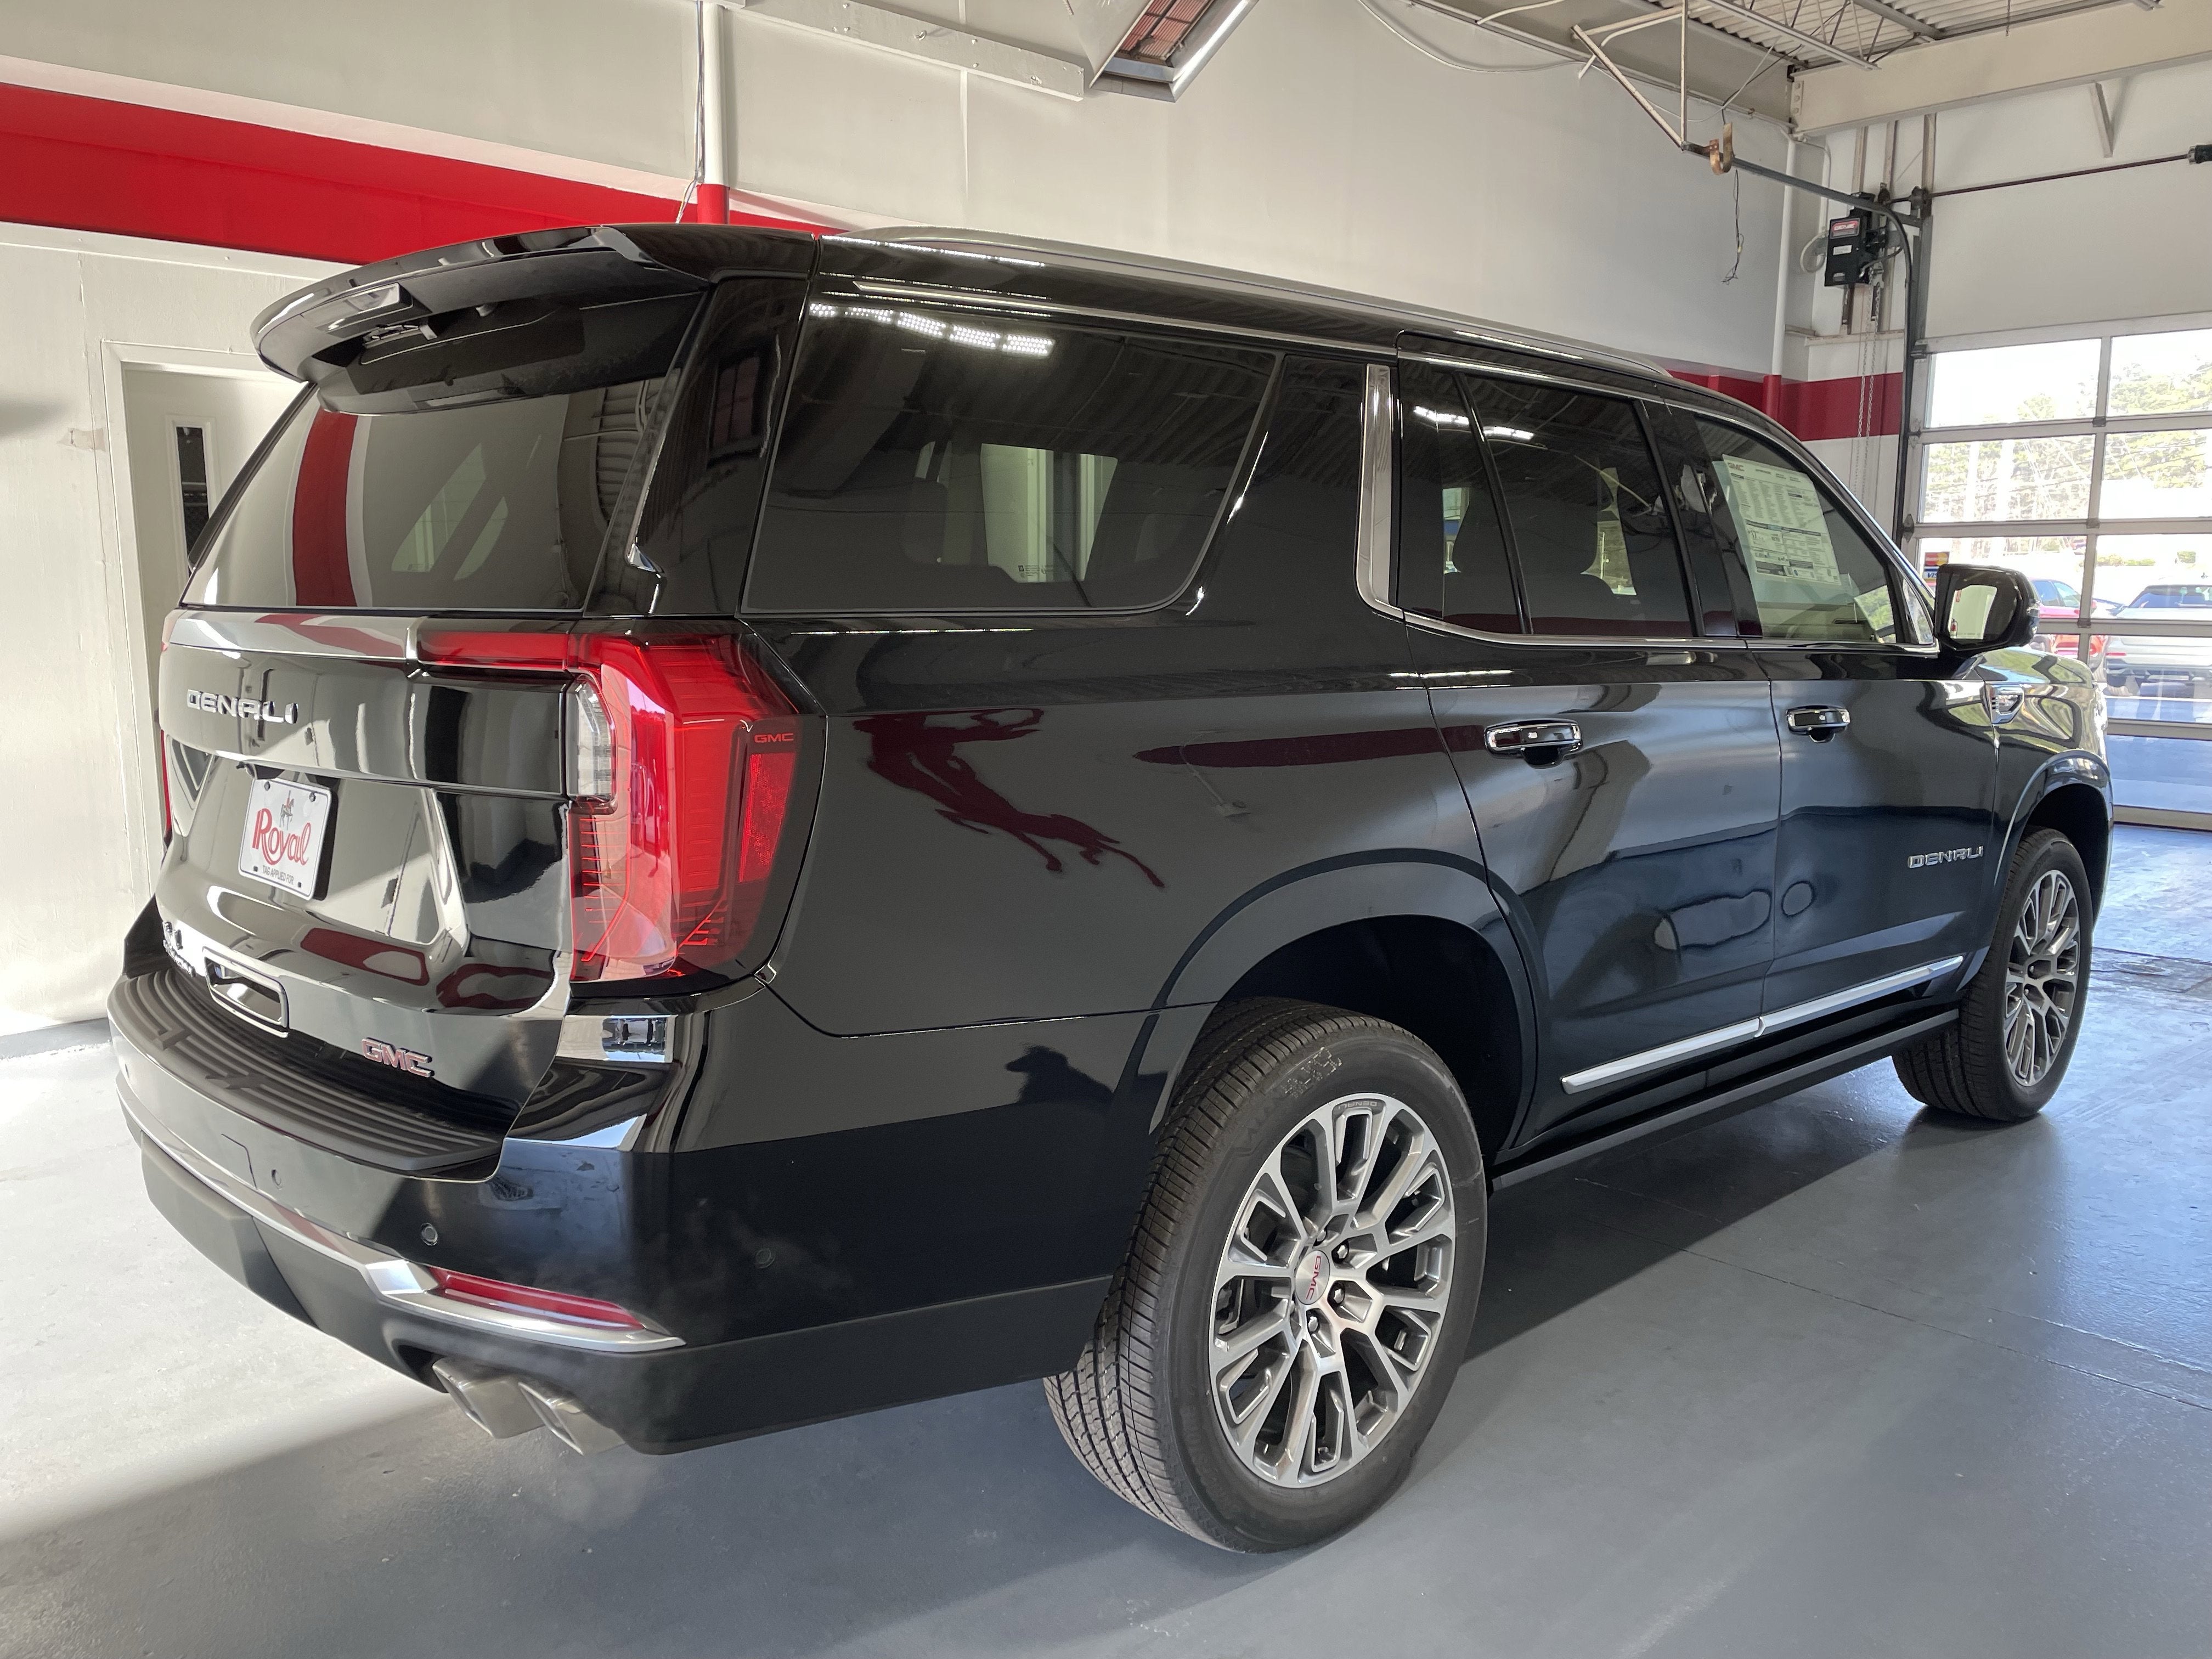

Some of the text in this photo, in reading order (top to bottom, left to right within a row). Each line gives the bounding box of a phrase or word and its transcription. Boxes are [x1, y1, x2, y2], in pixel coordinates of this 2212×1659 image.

[1728, 462, 1745, 472] GMC
[187, 689, 298, 724] DENALI
[754, 733, 794, 743] GMC
[252, 808, 311, 866] Royal
[1908, 845, 1984, 868] DENALI
[262, 865, 294, 885] TAG APPLIED FOR
[362, 1037, 435, 1077] GMC
[1338, 1101, 1377, 1110] DENALI
[1306, 1255, 1322, 1300] GMC
